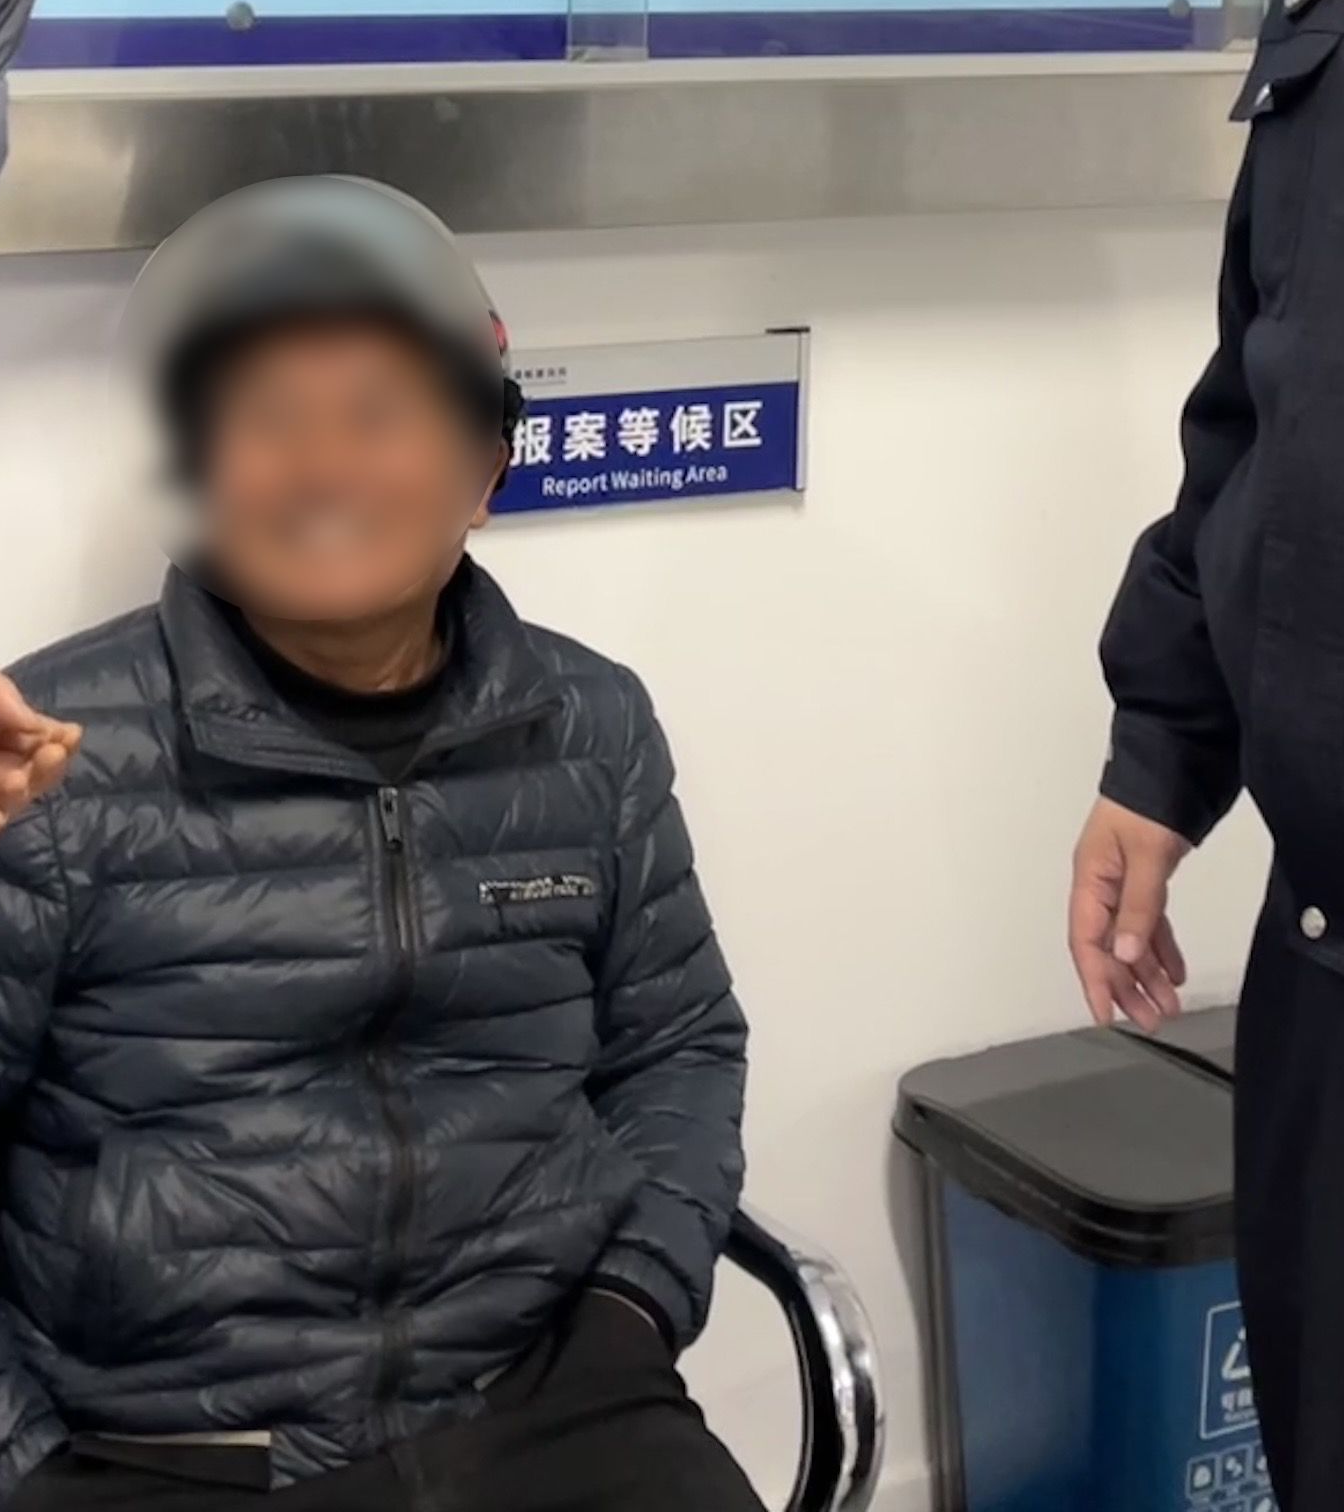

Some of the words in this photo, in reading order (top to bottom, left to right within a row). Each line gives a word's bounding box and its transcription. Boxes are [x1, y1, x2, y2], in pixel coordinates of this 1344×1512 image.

[510, 400, 764, 467] 报案等候区
[542, 474, 609, 497] Report
[612, 468, 684, 492] Waiting
[687, 464, 728, 483] Area
